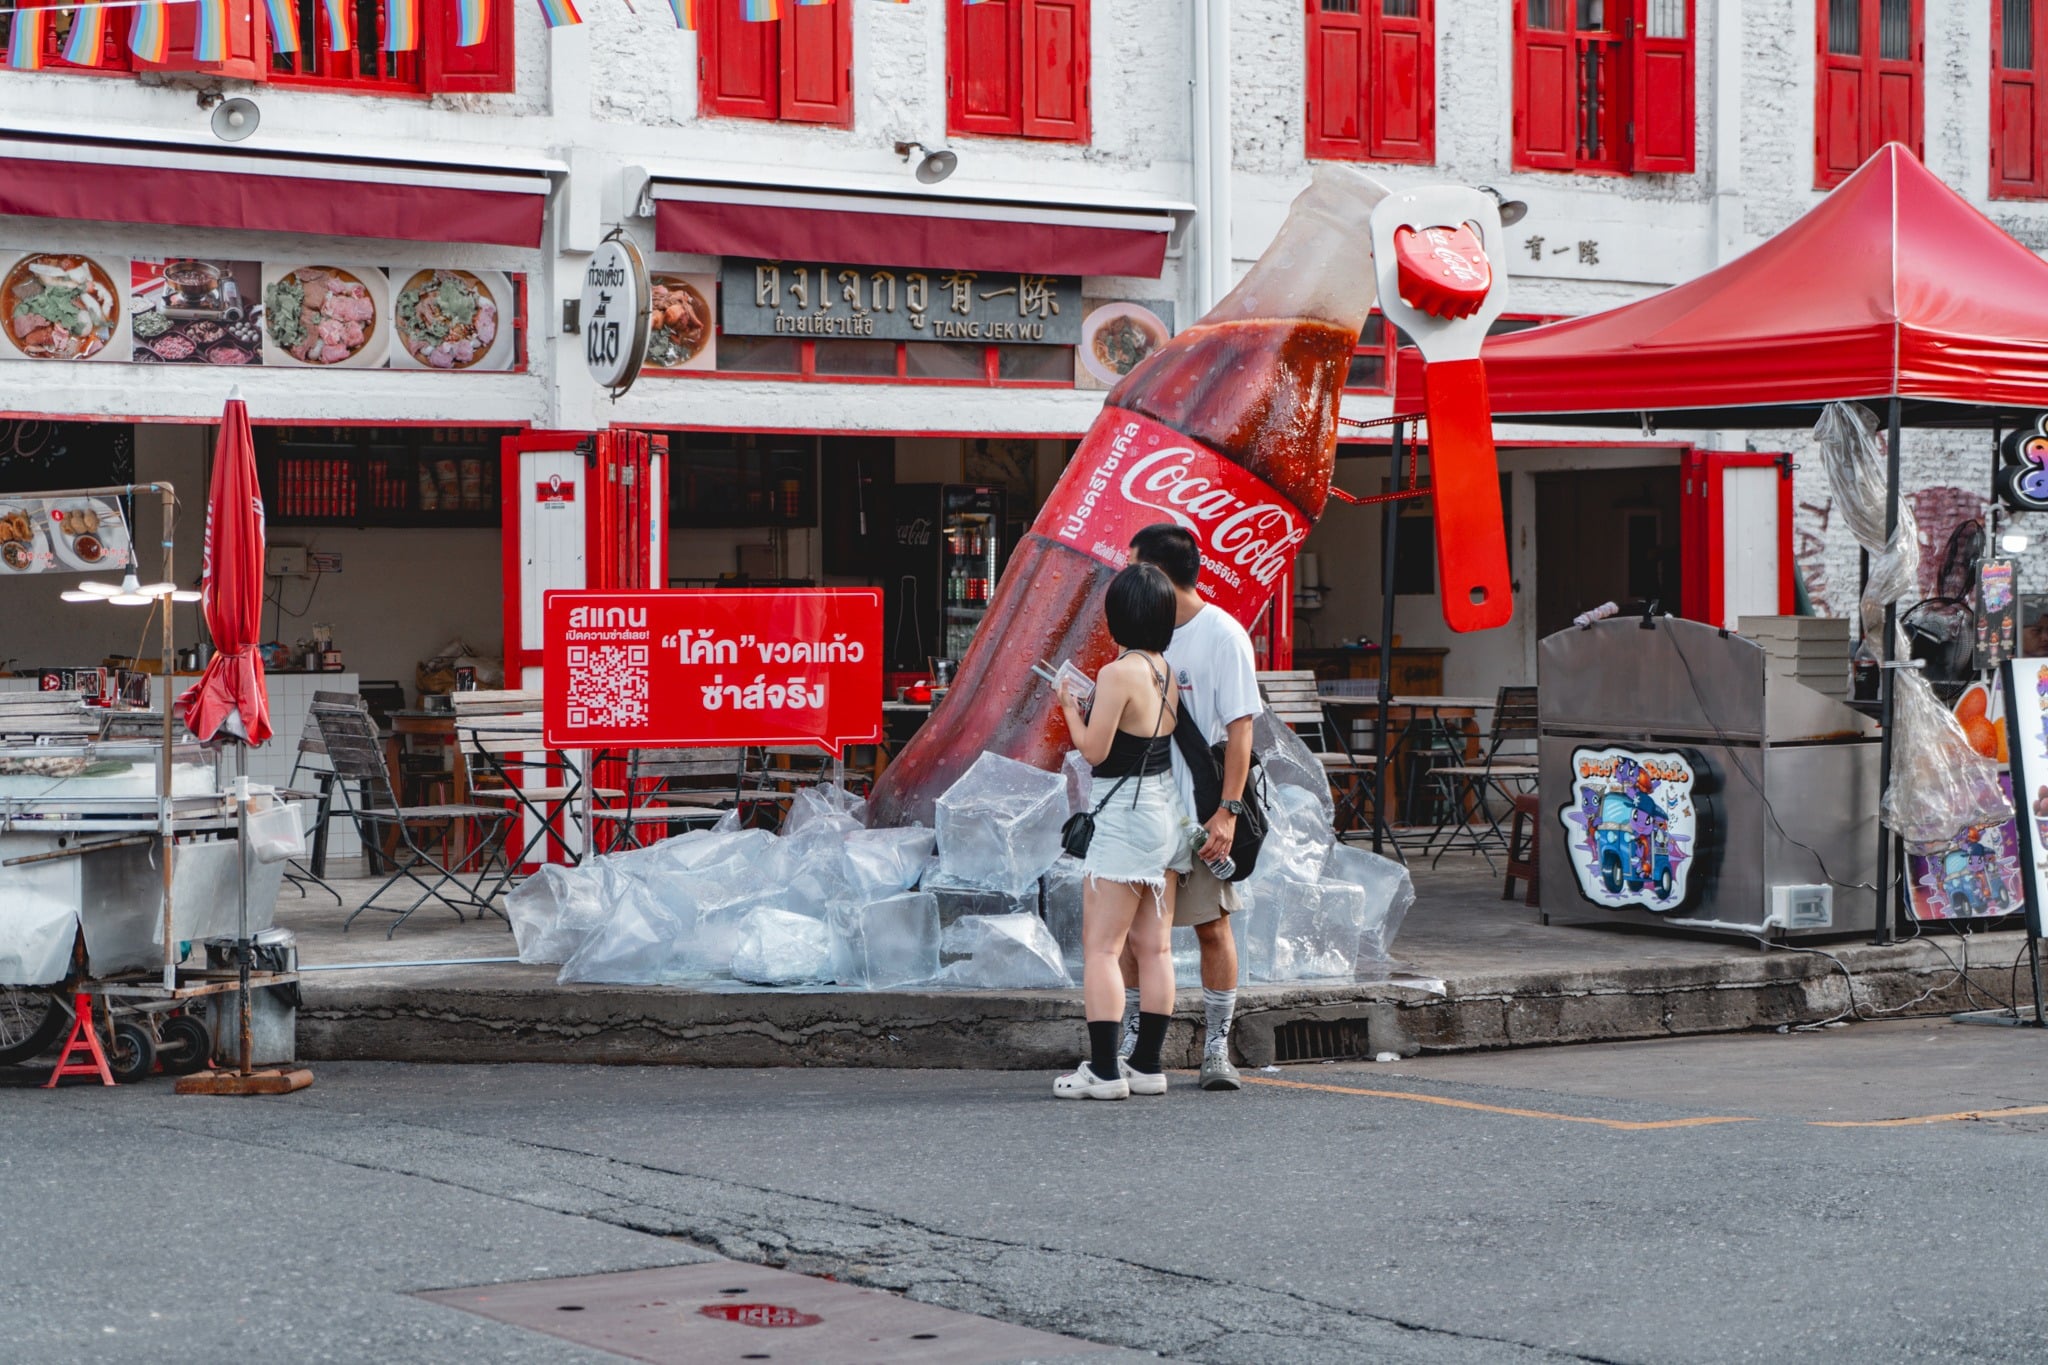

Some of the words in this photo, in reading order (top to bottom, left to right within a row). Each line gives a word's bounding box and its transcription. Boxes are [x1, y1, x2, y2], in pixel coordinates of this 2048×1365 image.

[933, 320, 979, 338] TANG
[983, 322, 1014, 338] JEK
[1017, 323, 1044, 339] WU
[1058, 421, 1141, 541] โปรดรีไซเคิล
[1120, 447, 1304, 587] Coca-Cola
[569, 606, 647, 628] สแกน
[565, 629, 650, 641] เปิดความซ่าส์เลย!
[700, 674, 825, 711] ซ่าส์จริง
